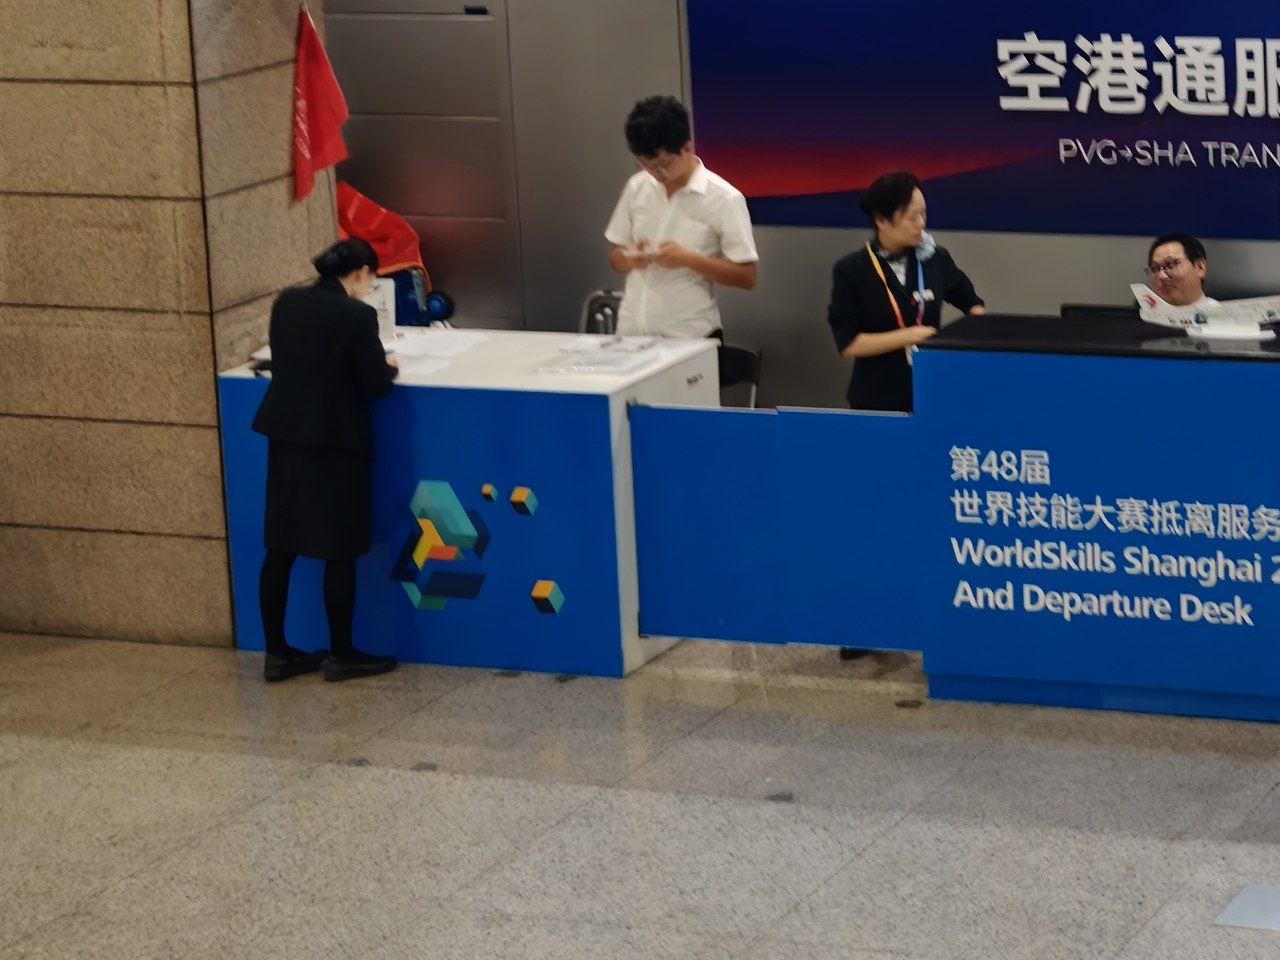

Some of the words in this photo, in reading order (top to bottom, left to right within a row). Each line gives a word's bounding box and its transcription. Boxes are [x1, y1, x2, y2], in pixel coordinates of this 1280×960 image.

[949, 445, 1051, 486] 第48届
[950, 536, 1117, 574] WorldSkills
[1123, 545, 1263, 588] Shanghai
[952, 579, 1015, 611] And
[1022, 583, 1172, 622] Departure
[1179, 592, 1255, 627] Desk
